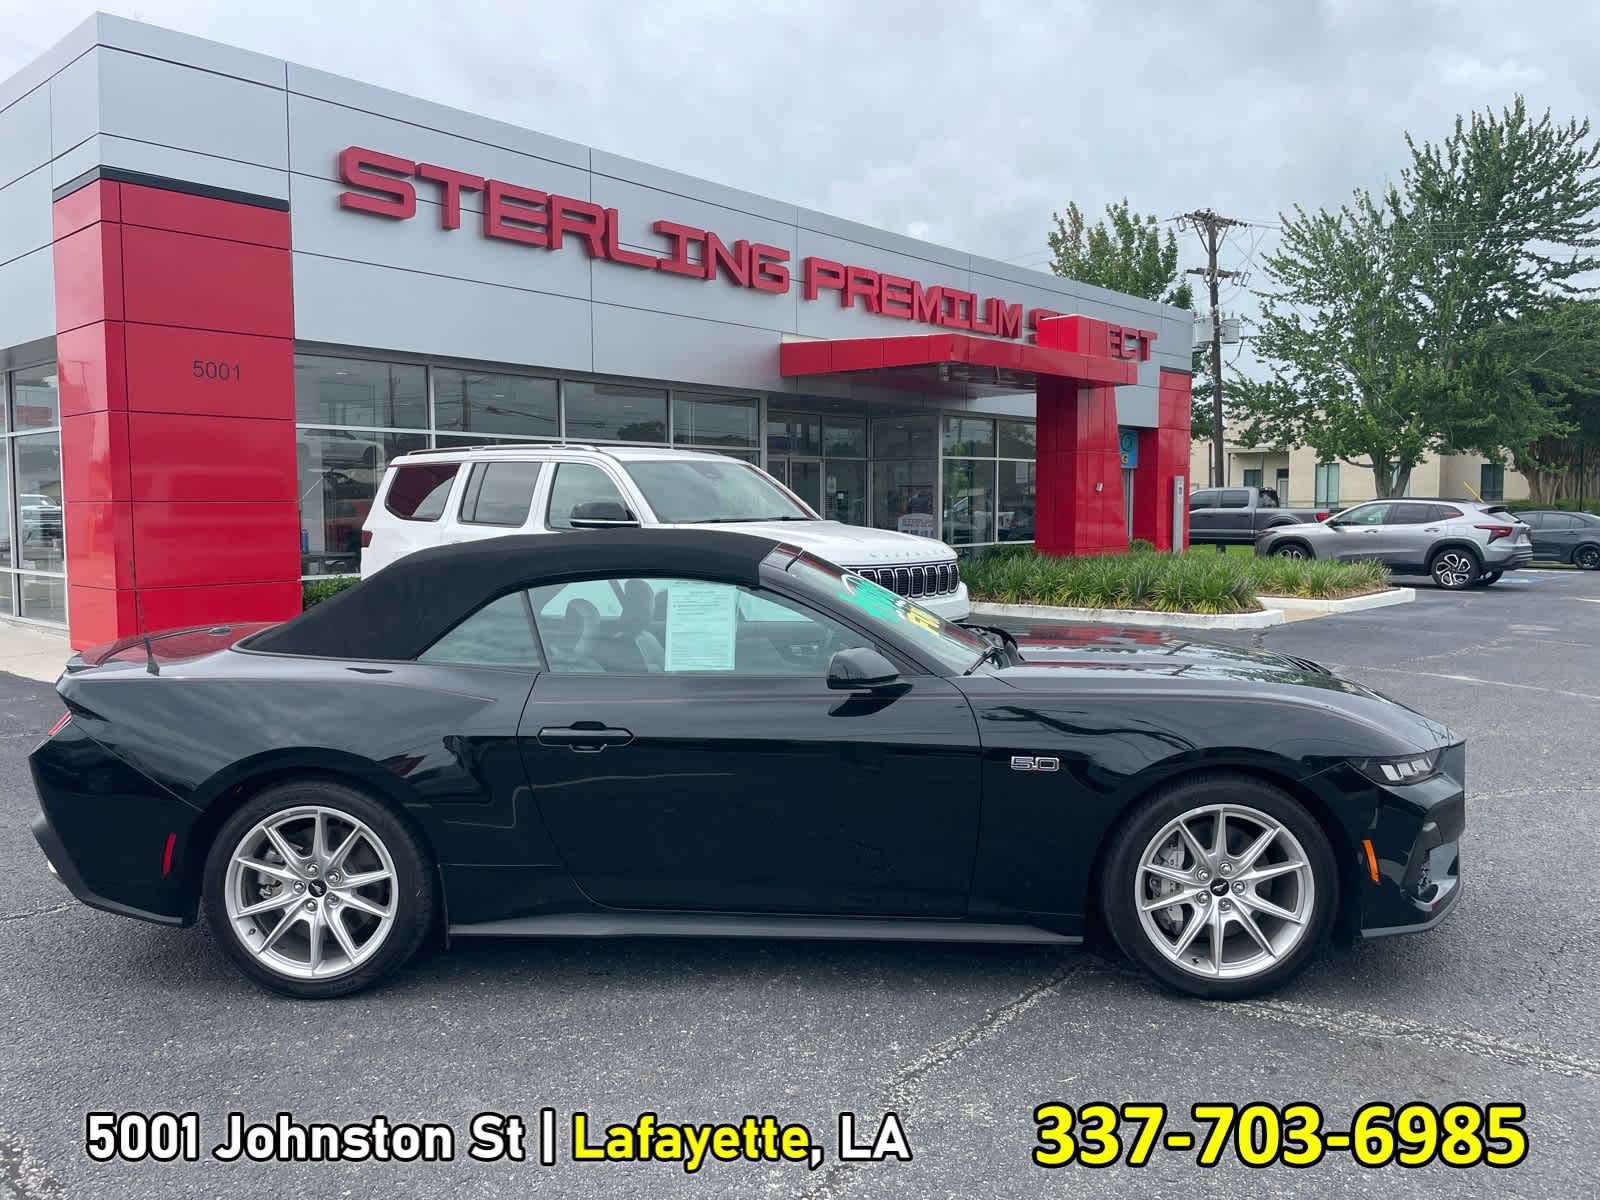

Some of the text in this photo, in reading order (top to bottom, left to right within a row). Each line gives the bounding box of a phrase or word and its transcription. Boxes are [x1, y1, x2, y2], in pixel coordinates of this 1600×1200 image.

[339, 146, 790, 294] STERLING
[804, 256, 1023, 339] PREMIUM
[193, 360, 240, 382] 5001
[1011, 756, 1060, 771] 5.0
